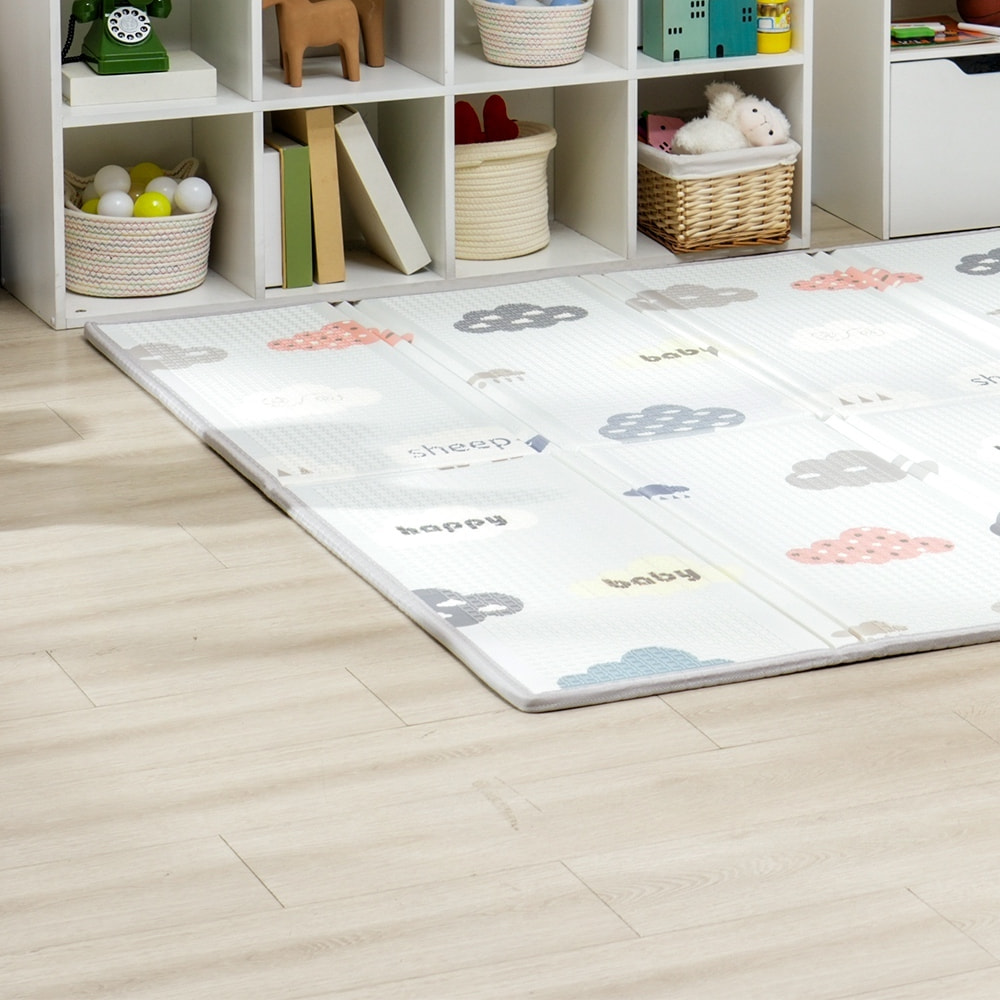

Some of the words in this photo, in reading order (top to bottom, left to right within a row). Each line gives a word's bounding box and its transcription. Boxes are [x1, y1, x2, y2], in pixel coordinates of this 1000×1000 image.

[408, 436, 512, 459] sheep
[396, 514, 508, 536] happy
[601, 568, 701, 589] baby
